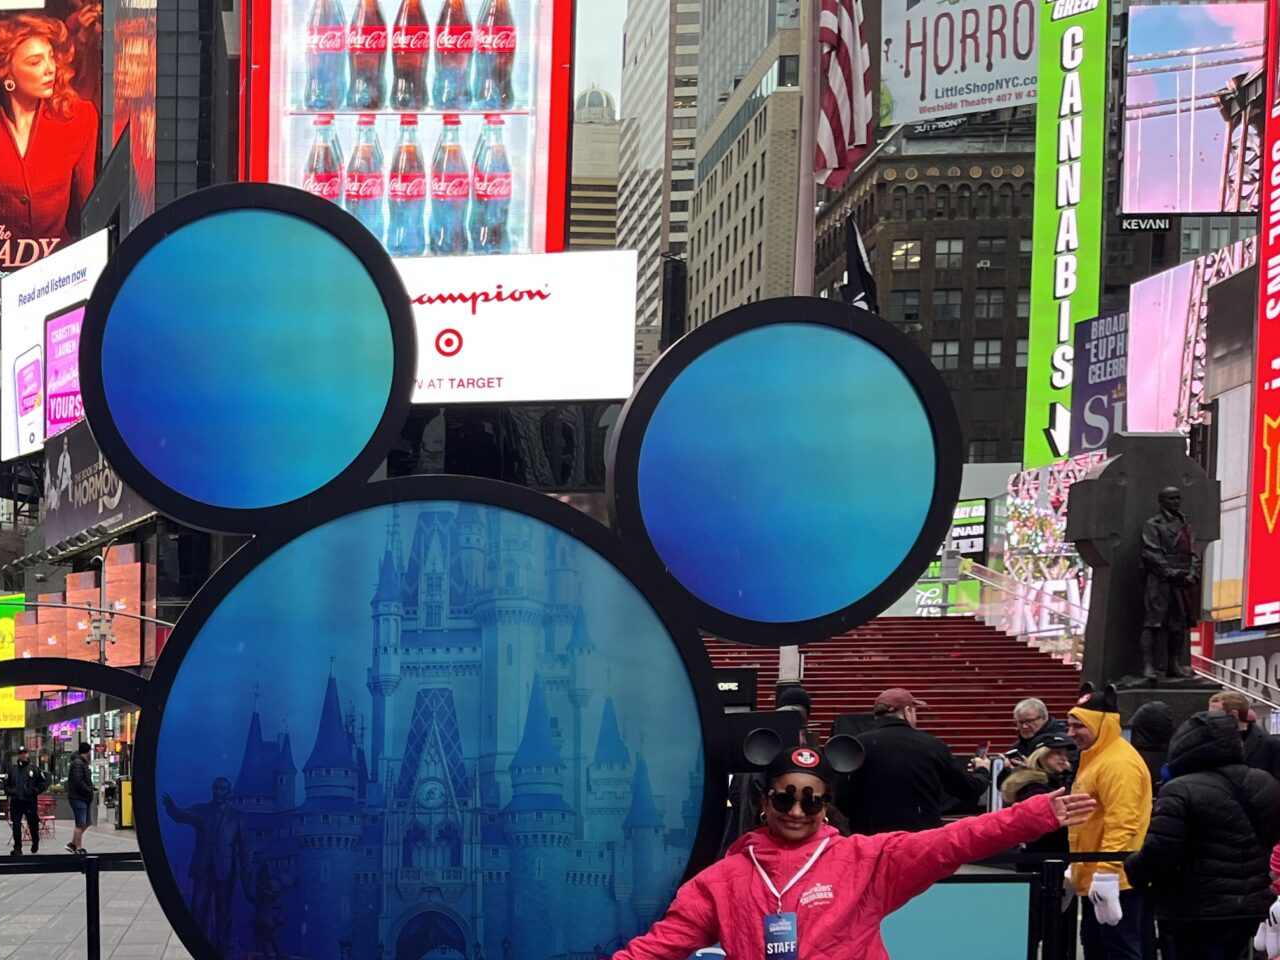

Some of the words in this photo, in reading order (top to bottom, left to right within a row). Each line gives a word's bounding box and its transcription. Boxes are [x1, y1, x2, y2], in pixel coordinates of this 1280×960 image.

[918, 101, 958, 114] Westside
[961, 96, 993, 109] Theatre
[996, 93, 1012, 103] 407
[1015, 92, 1026, 101] W
[1052, 25, 1084, 388] CANNABIS
[1122, 219, 1169, 230] KEVANI
[18, 289, 36, 307] Read
[36, 284, 50, 299] and
[50, 277, 70, 292] listen
[71, 267, 87, 284] now
[411, 284, 551, 315] ampion
[427, 379, 444, 389] AT
[448, 377, 503, 389] TARGET
[74, 468, 118, 509] MORMON
[766, 941, 796, 955] STAFF
